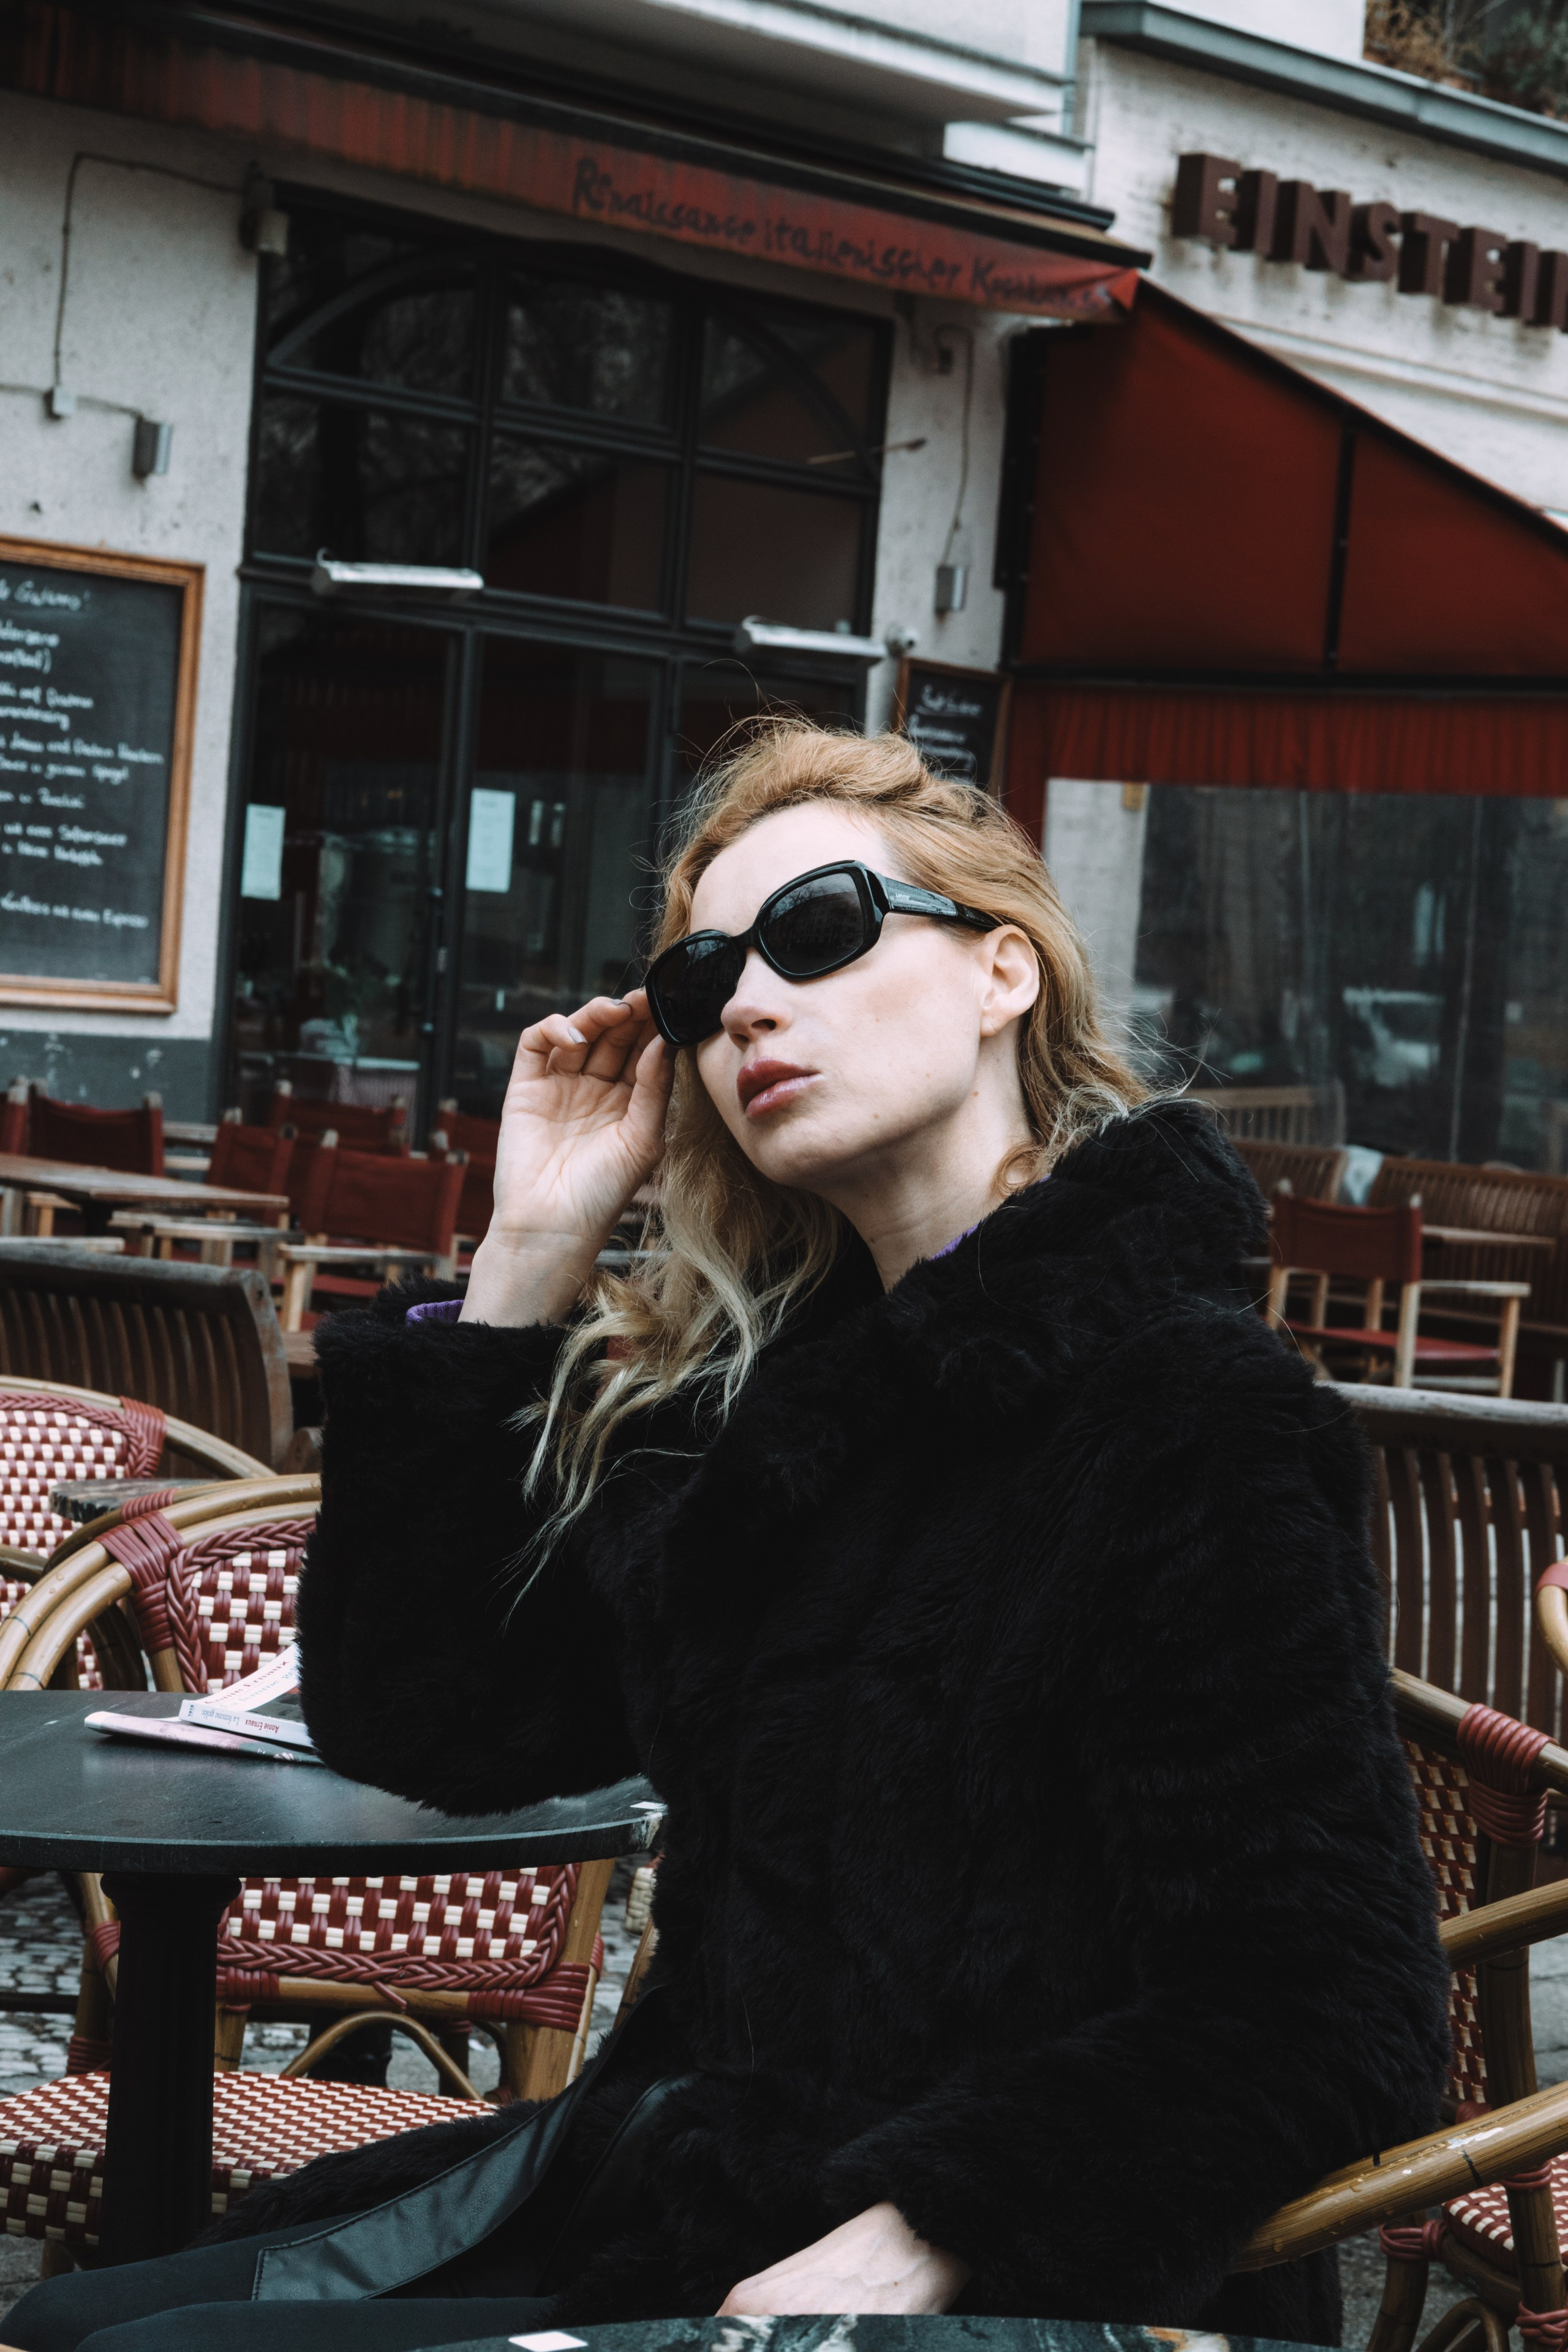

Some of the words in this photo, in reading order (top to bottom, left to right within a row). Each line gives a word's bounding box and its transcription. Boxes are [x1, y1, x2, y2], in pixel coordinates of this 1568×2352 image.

[244, 1660, 289, 1687] Ernaux
[215, 1713, 232, 1724] femme
[233, 1717, 239, 1725] La
[246, 1719, 263, 1730] Ernaux
[264, 1723, 279, 1733] Annie
